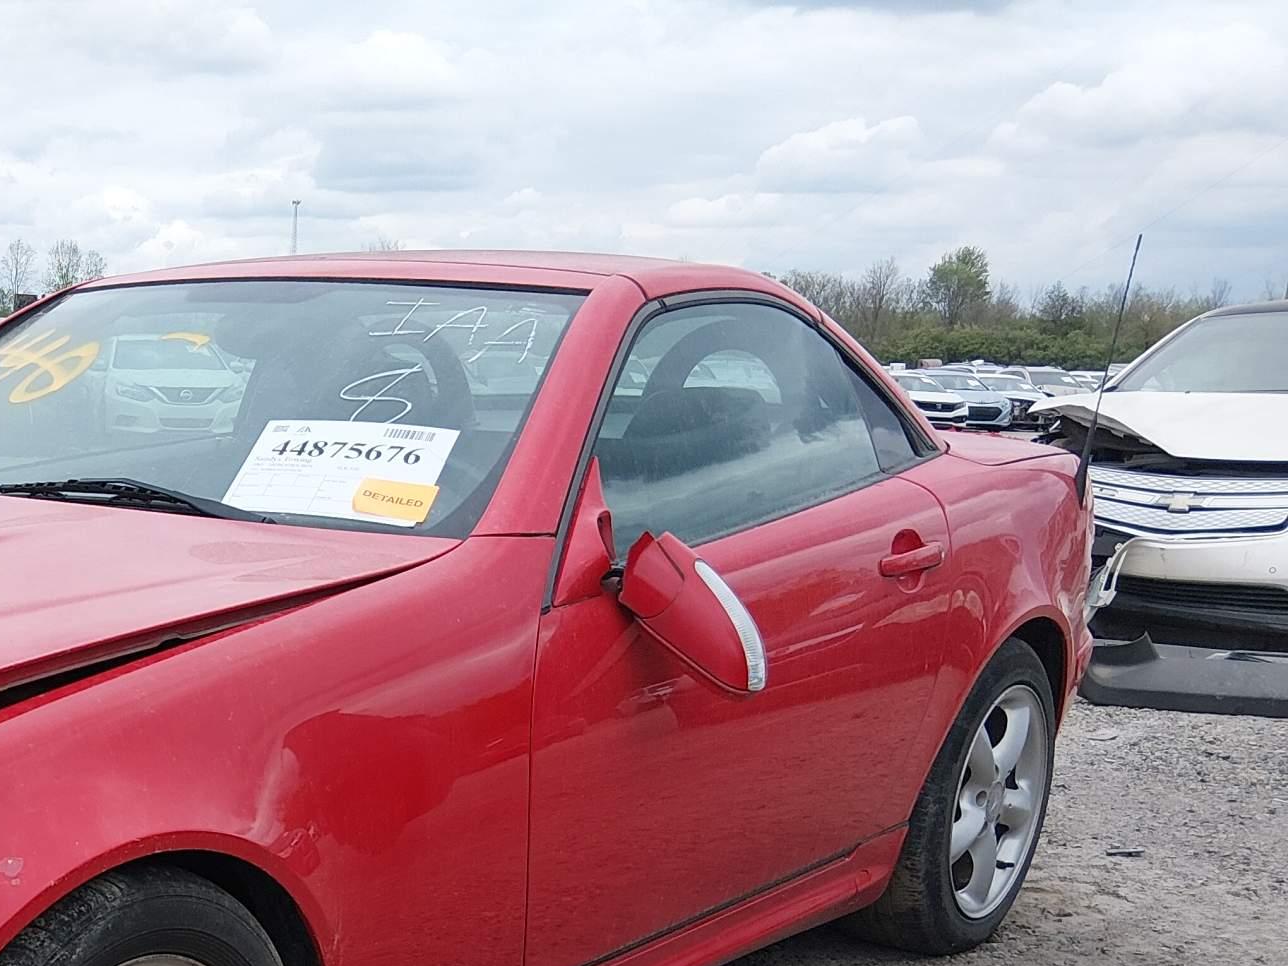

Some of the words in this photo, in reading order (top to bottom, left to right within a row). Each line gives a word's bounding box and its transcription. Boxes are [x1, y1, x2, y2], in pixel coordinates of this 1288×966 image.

[369, 298, 538, 364] IAA
[271, 439, 423, 465] 44875676
[362, 489, 424, 508] DETAILED
